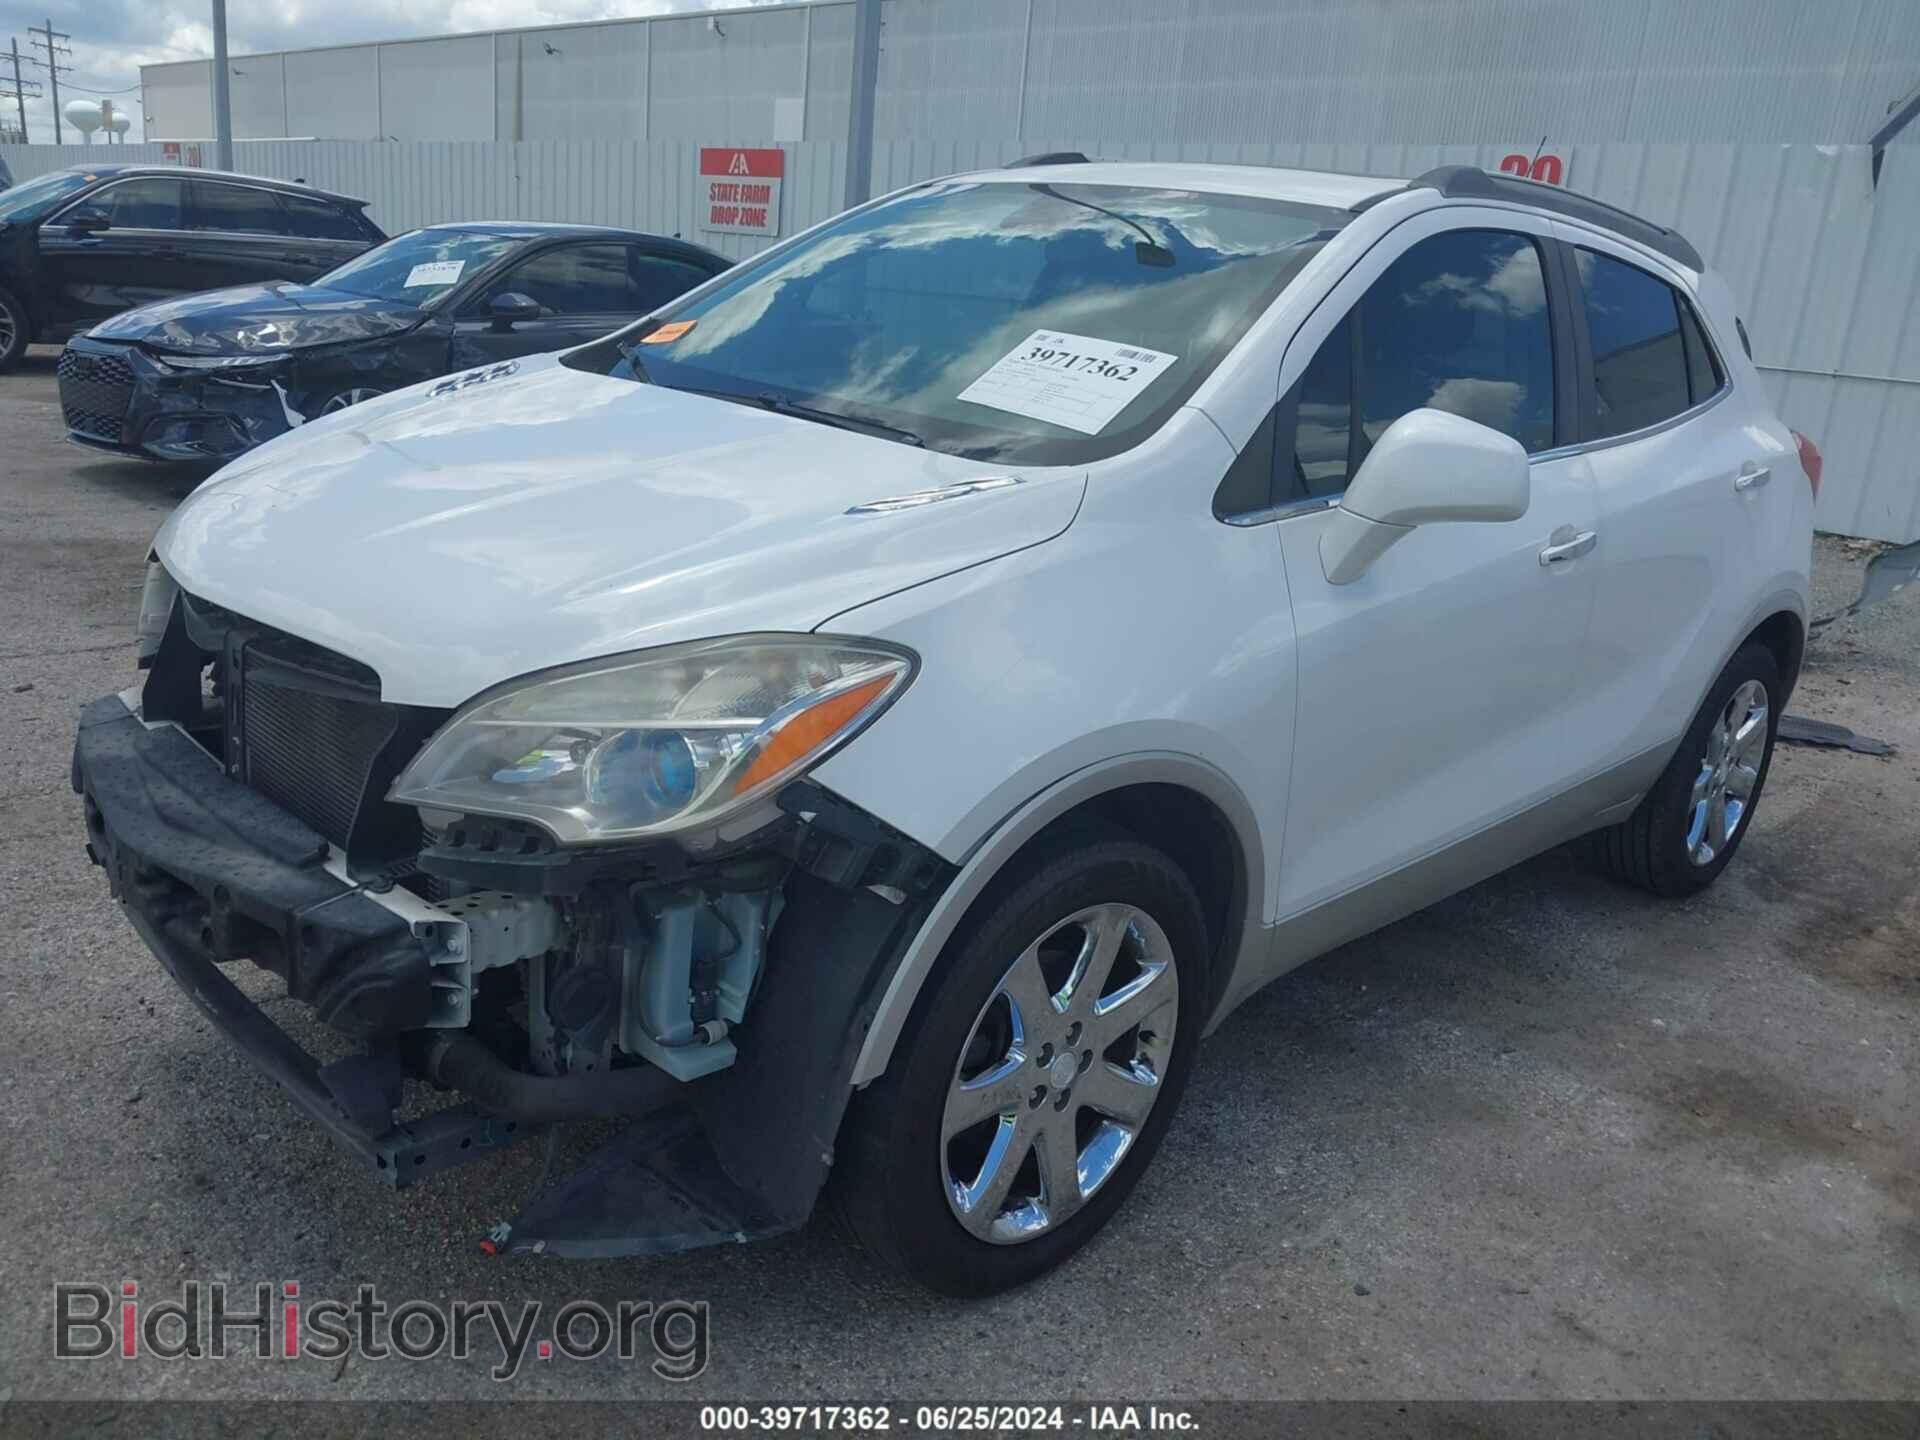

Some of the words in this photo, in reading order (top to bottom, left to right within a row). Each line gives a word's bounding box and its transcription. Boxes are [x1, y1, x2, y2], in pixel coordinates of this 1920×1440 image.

[709, 182, 738, 202] STATE
[741, 184, 771, 204] FARM
[710, 205, 739, 225] DROP
[739, 207, 768, 228] ZONE
[1020, 347, 1139, 381] 39717362
